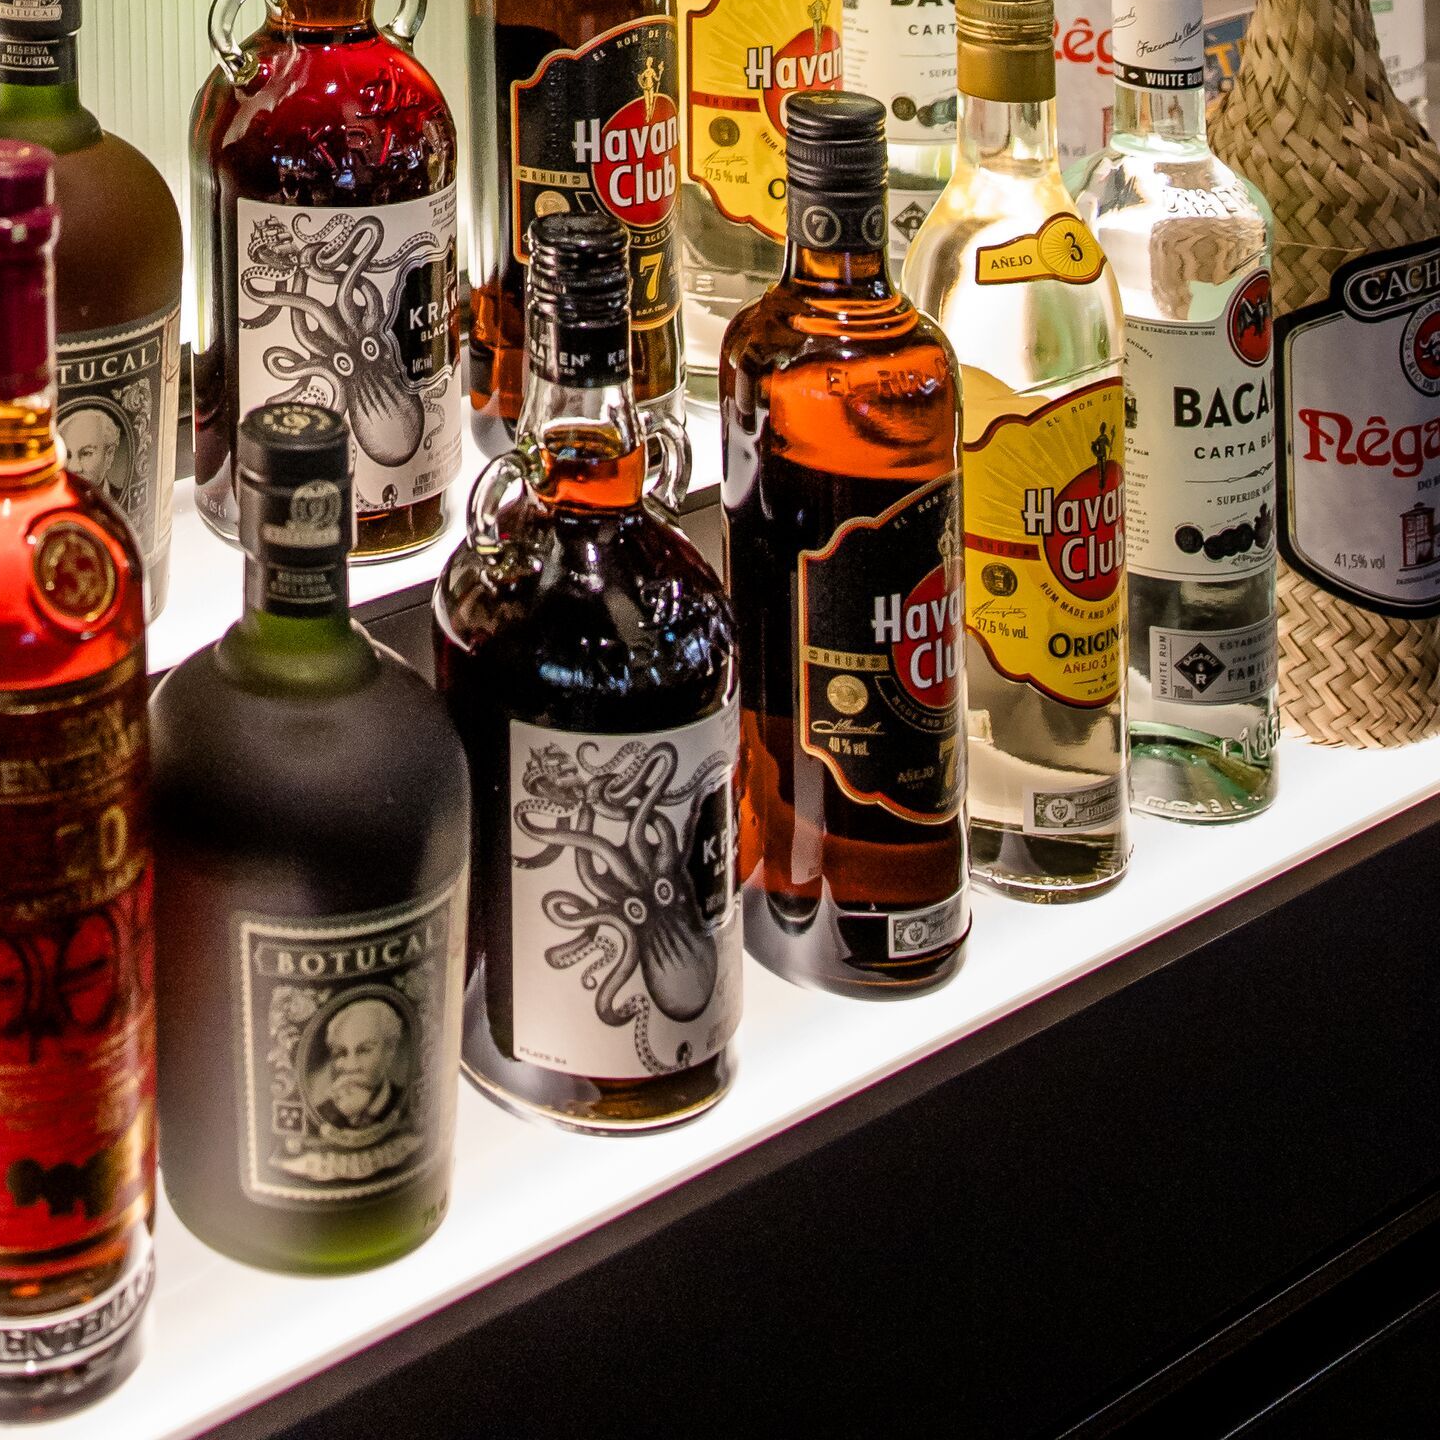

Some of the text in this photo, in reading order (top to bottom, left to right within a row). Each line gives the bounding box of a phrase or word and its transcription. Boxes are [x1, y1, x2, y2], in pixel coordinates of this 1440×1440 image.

[6, 44, 49, 56] RESERVA
[591, 49, 607, 62] EL
[615, 33, 640, 50] RON
[648, 29, 659, 39] DE
[0, 54, 56, 67] EXCLUSIVA
[1145, 71, 1185, 87] WHITE
[760, 130, 779, 152] RUM
[531, 172, 568, 185] RHUM
[609, 155, 677, 208] Club
[811, 214, 829, 240] 7
[1064, 231, 1083, 262] 3
[990, 254, 1033, 270] AÑEJO
[638, 251, 664, 303] 7
[1140, 325, 1188, 336] ESTABLECIDA
[1173, 375, 1274, 429] BACA
[1046, 416, 1060, 428] EL
[1070, 400, 1093, 414] RON
[1193, 440, 1256, 460] CARTA
[917, 495, 940, 514] RON
[1216, 489, 1261, 506] SUPERIOR
[1061, 523, 1126, 582] Club
[1333, 552, 1386, 570] 41,5% vol
[1040, 582, 1060, 604] RUM
[1060, 601, 1086, 619] MADE
[1088, 609, 1105, 621] AND
[998, 622, 1010, 637] %
[822, 654, 867, 669] RHUM
[1062, 658, 1100, 675] AÑEJO
[1100, 654, 1109, 670] 3
[1159, 661, 1168, 696] WHITE
[1195, 673, 1207, 685] R
[828, 736, 841, 754] 40
[841, 737, 853, 756] %
